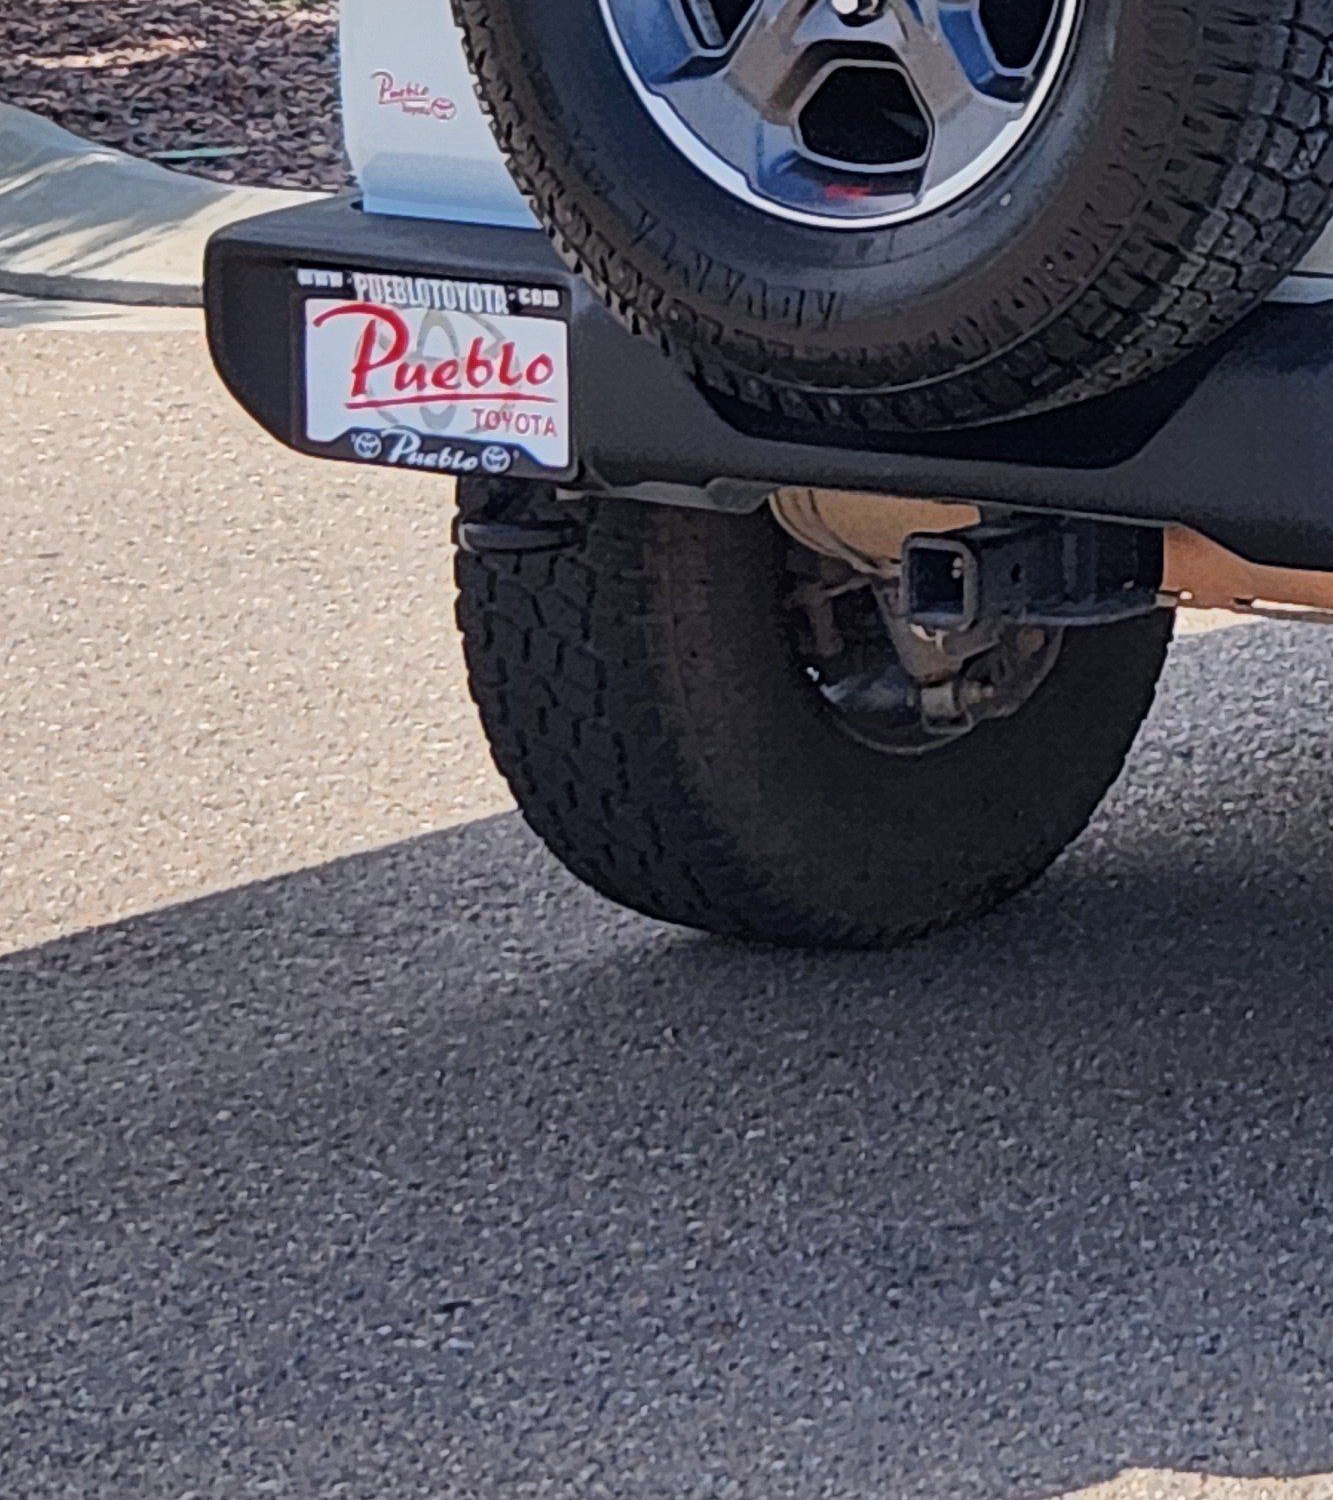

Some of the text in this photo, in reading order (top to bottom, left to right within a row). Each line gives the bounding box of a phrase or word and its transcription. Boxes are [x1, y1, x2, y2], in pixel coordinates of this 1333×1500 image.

[313, 303, 554, 397] Pueblo
[472, 407, 558, 438] TOYOTA
[381, 428, 479, 471] Pueblo
